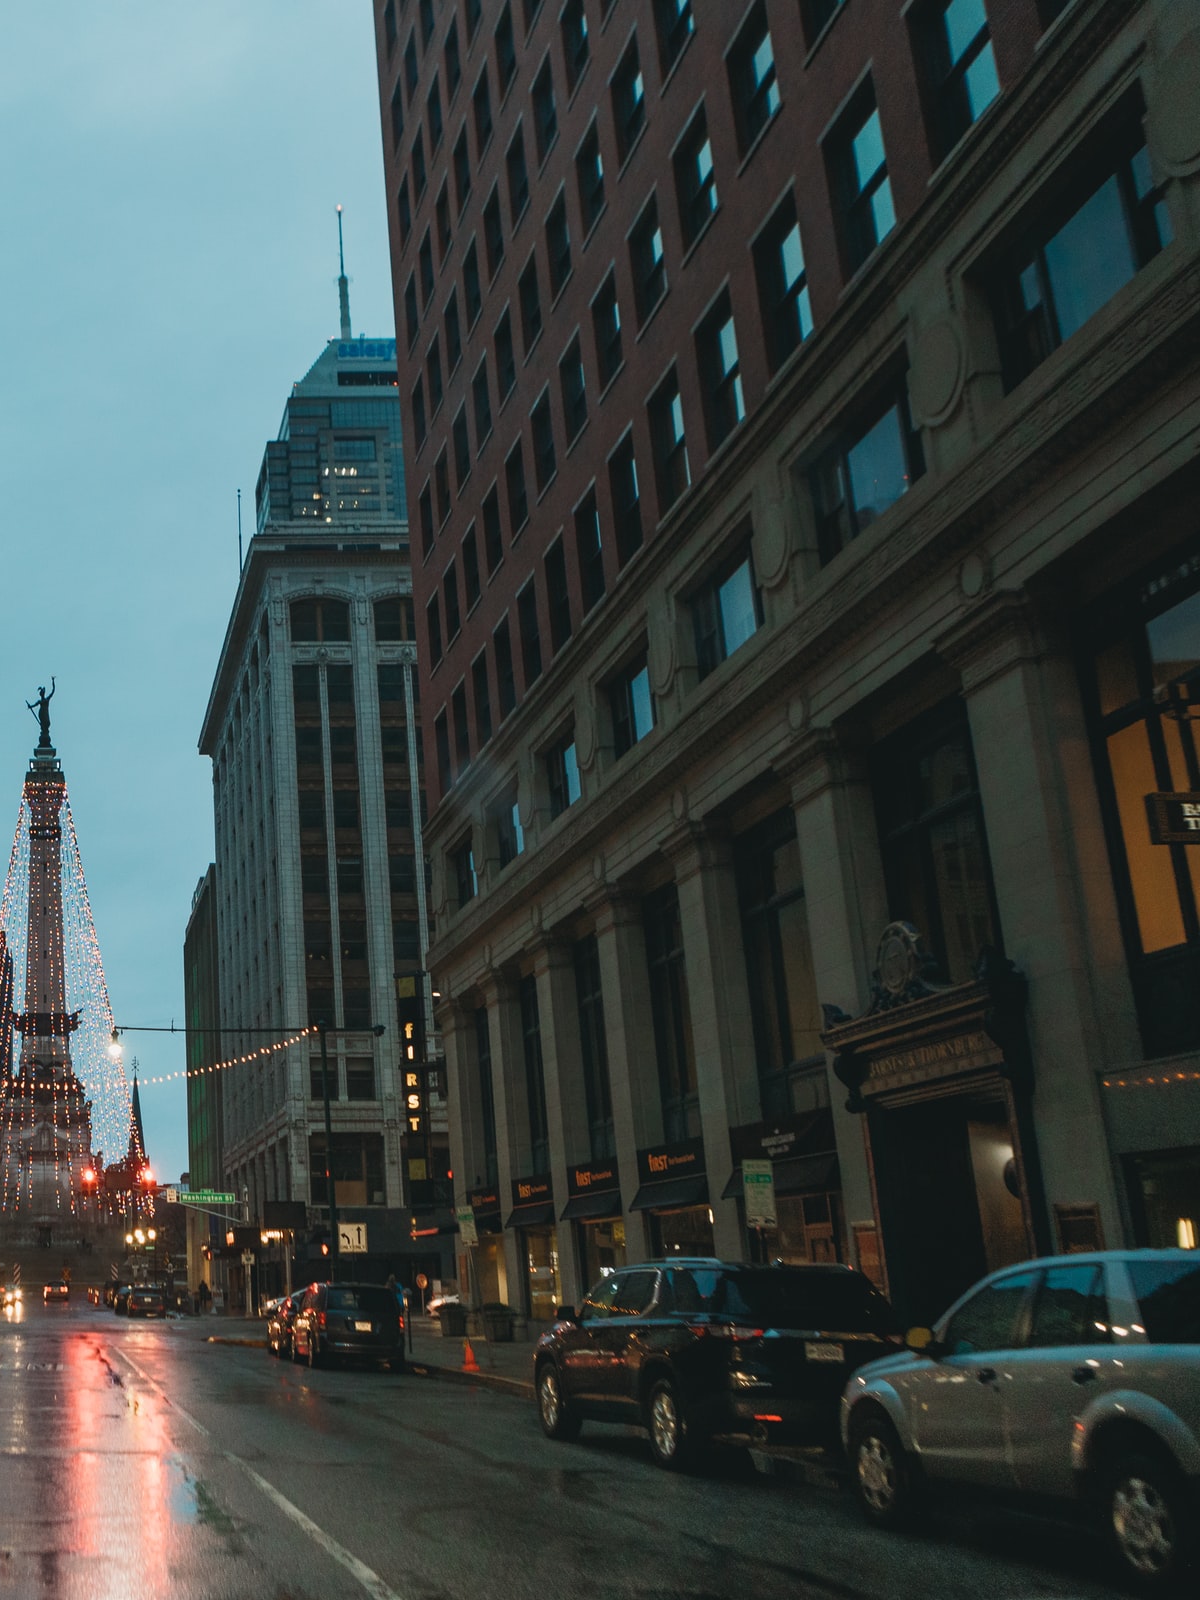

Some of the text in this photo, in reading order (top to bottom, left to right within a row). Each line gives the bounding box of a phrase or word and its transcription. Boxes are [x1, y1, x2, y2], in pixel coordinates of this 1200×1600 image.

[339, 333, 397, 361] salesf
[182, 1194, 223, 1202] Washington
[225, 1194, 233, 1202] St
